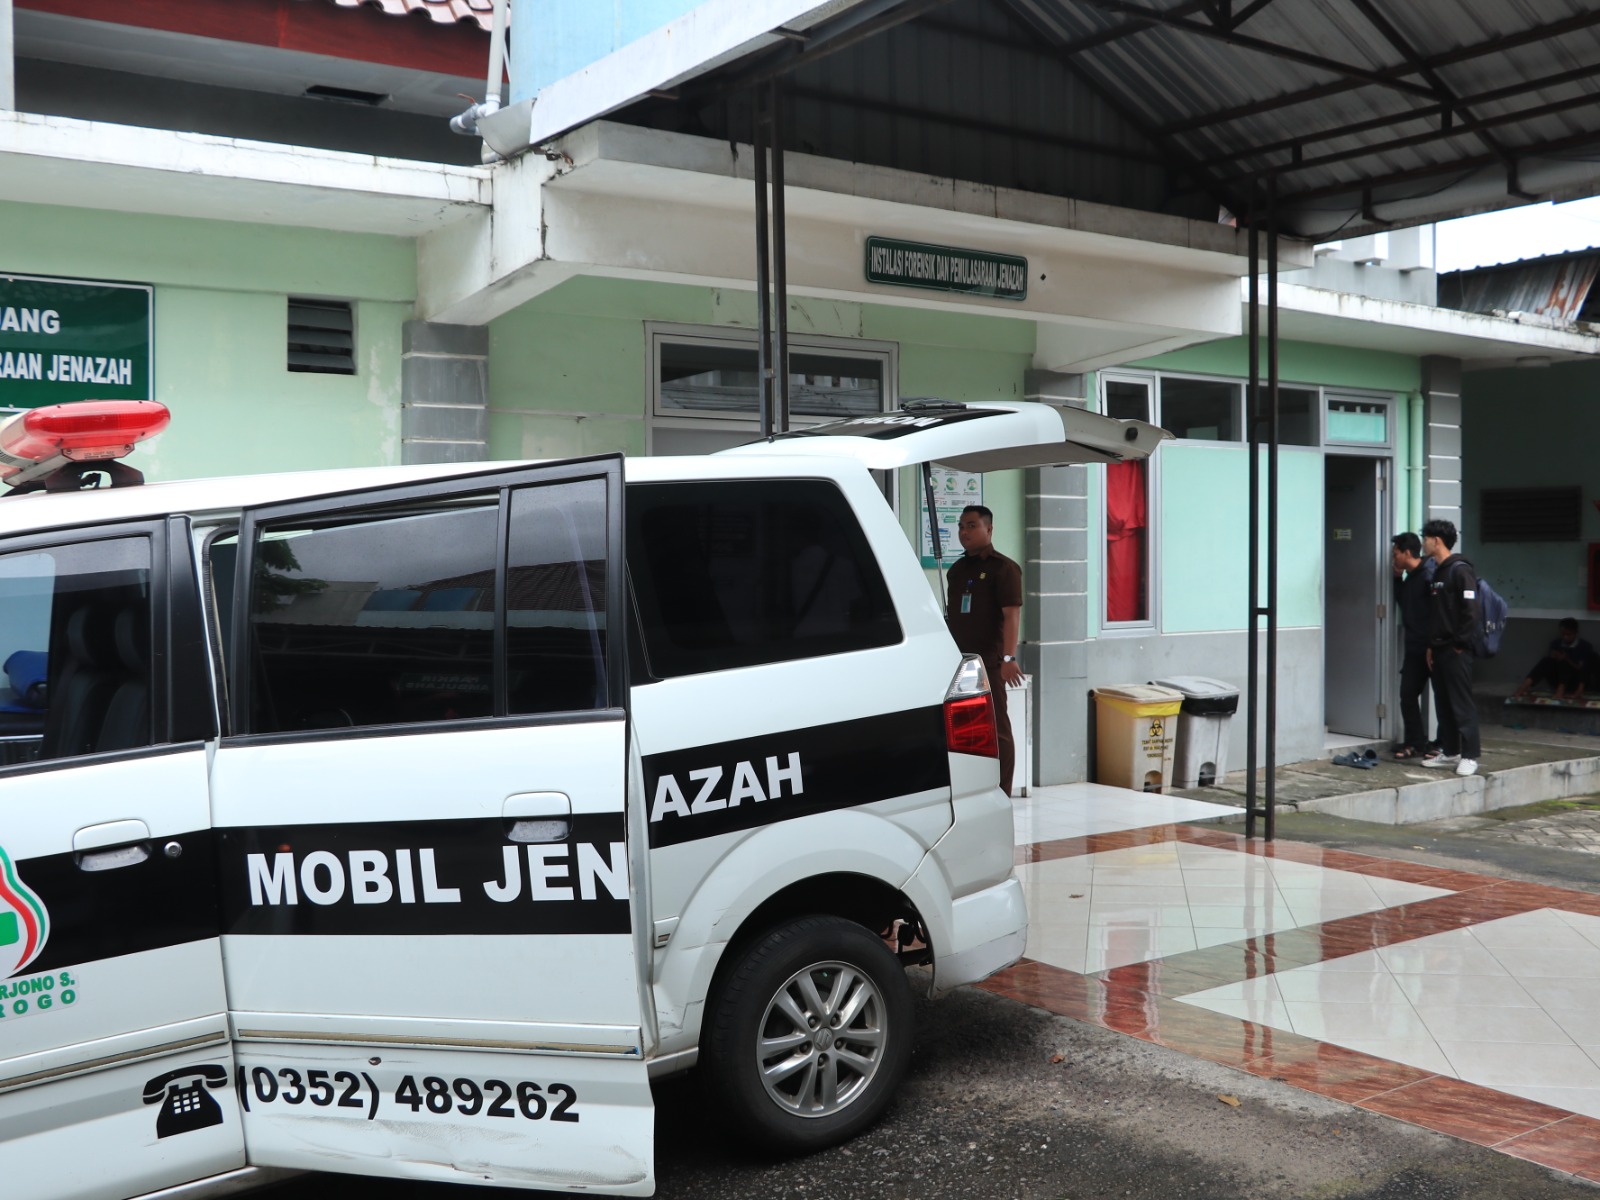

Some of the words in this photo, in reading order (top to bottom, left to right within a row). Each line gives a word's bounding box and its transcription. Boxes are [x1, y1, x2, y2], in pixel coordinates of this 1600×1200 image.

[871, 246, 903, 275] INSTALASI
[905, 251, 935, 279] FORENSIK
[936, 255, 950, 281] DAN
[950, 257, 997, 287] PEMULASARAAN
[997, 262, 1024, 290] JENAZAH
[0, 306, 60, 335] ANG
[47, 354, 132, 385] JENAZAH
[650, 751, 804, 823] AZAH
[248, 848, 462, 906] MOBIL
[483, 842, 630, 903] JEN
[60, 972, 76, 987] S.
[238, 1066, 380, 1121] (0352)
[395, 1074, 579, 1123] 489262
